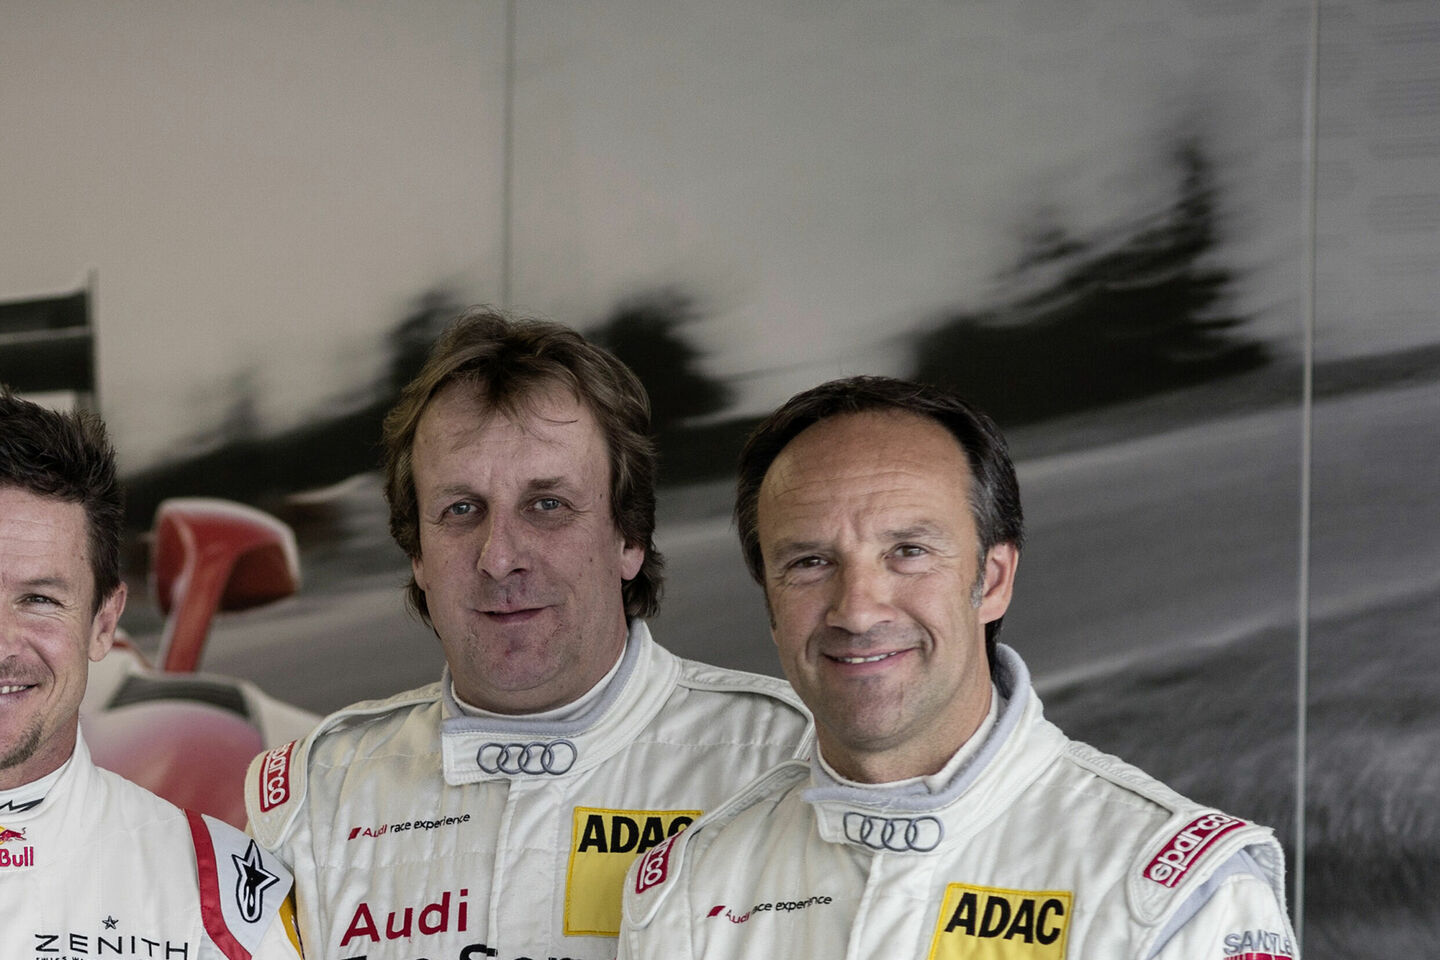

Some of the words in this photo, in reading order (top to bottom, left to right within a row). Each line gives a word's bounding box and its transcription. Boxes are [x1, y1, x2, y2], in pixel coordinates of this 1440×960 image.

[266, 744, 289, 804] parco
[362, 824, 388, 838] Audi
[390, 821, 412, 833] race
[414, 813, 471, 830] experience
[340, 888, 469, 947] Audi
[944, 891, 1064, 945] ADAC
